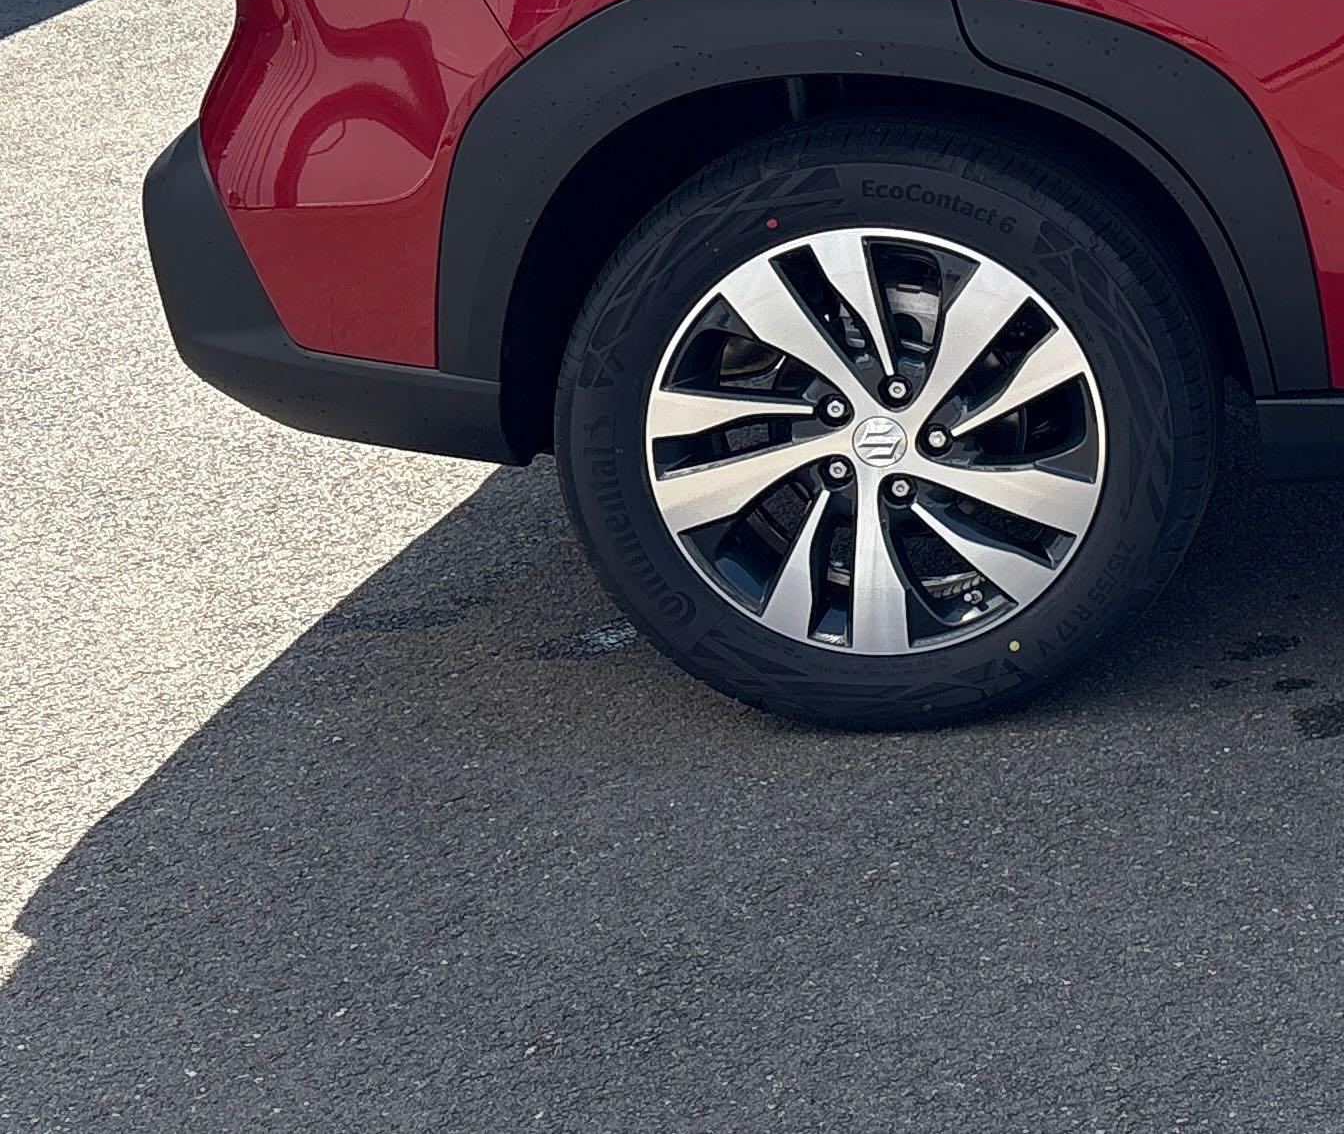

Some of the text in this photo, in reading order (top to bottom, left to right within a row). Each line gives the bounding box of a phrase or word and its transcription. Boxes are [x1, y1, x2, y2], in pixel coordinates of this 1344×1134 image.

[861, 179, 1019, 235] EcoContact 6
[583, 446, 697, 628] Continental
[1037, 538, 1137, 657] 215/55 R 17 V
